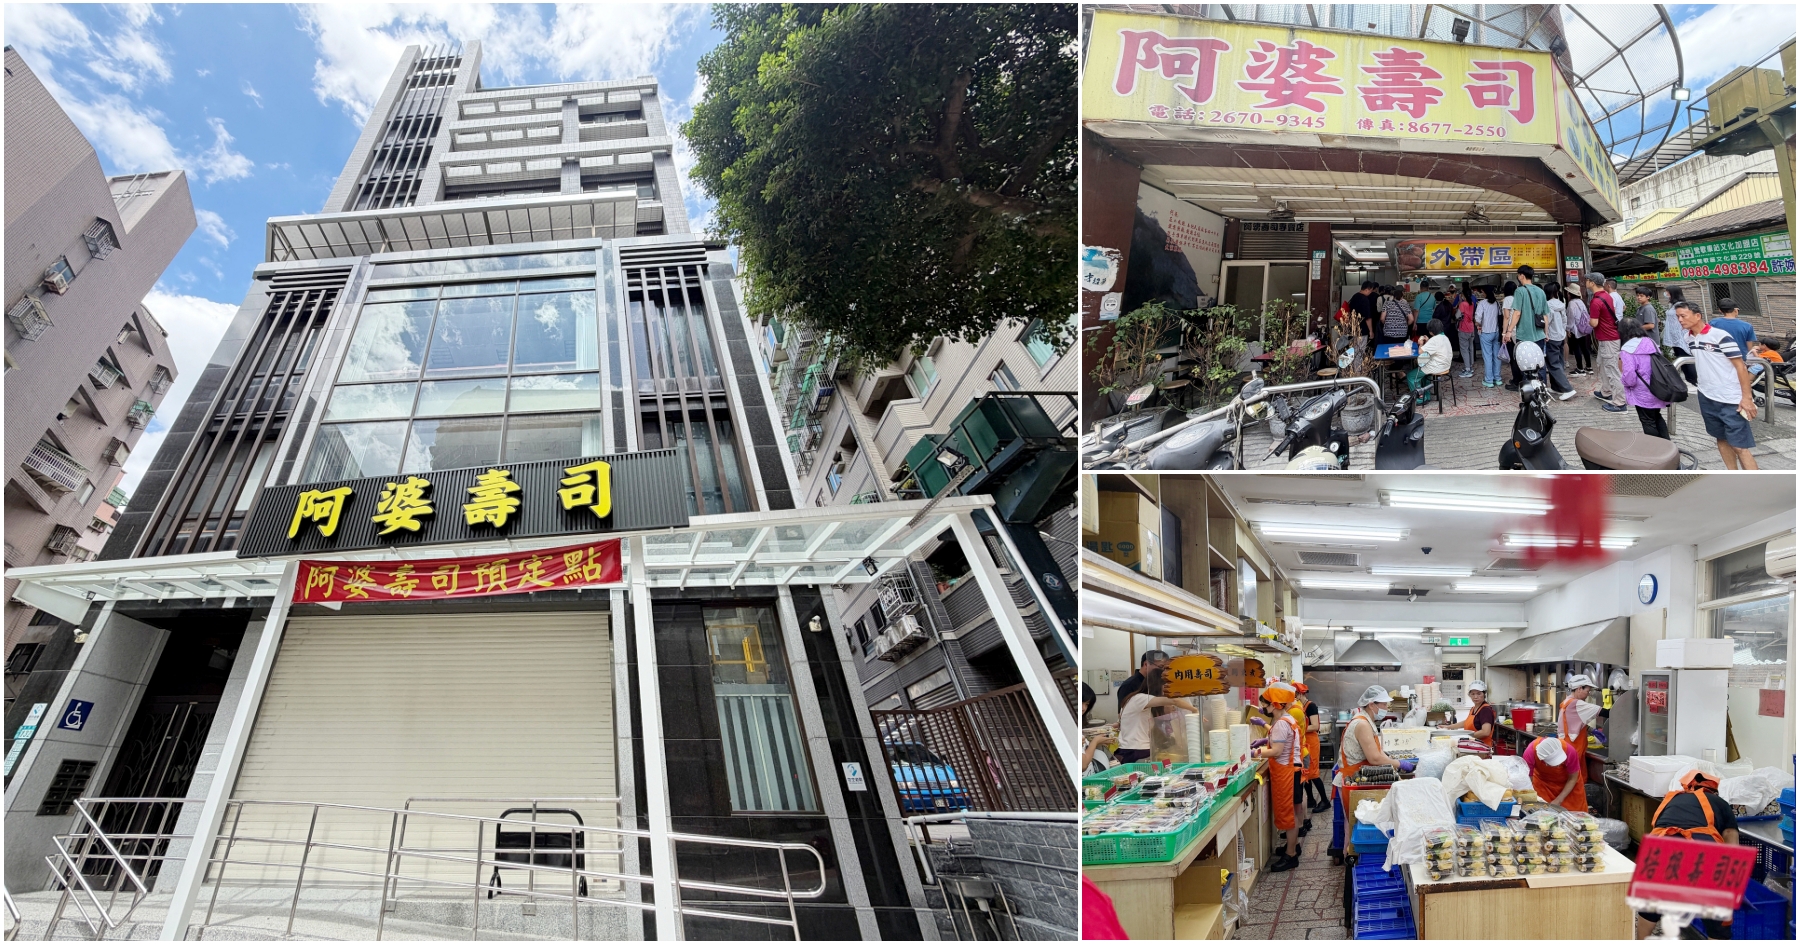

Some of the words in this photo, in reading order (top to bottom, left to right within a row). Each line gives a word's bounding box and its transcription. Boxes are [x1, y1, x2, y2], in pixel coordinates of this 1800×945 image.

[1113, 28, 1537, 125] 阿婆壽司
[1429, 246, 1513, 266] 外帶區
[1681, 260, 1769, 278] 0988-498384
[287, 460, 612, 539] 阿婆壽司
[304, 546, 603, 600] 阿婆壽司預定點
